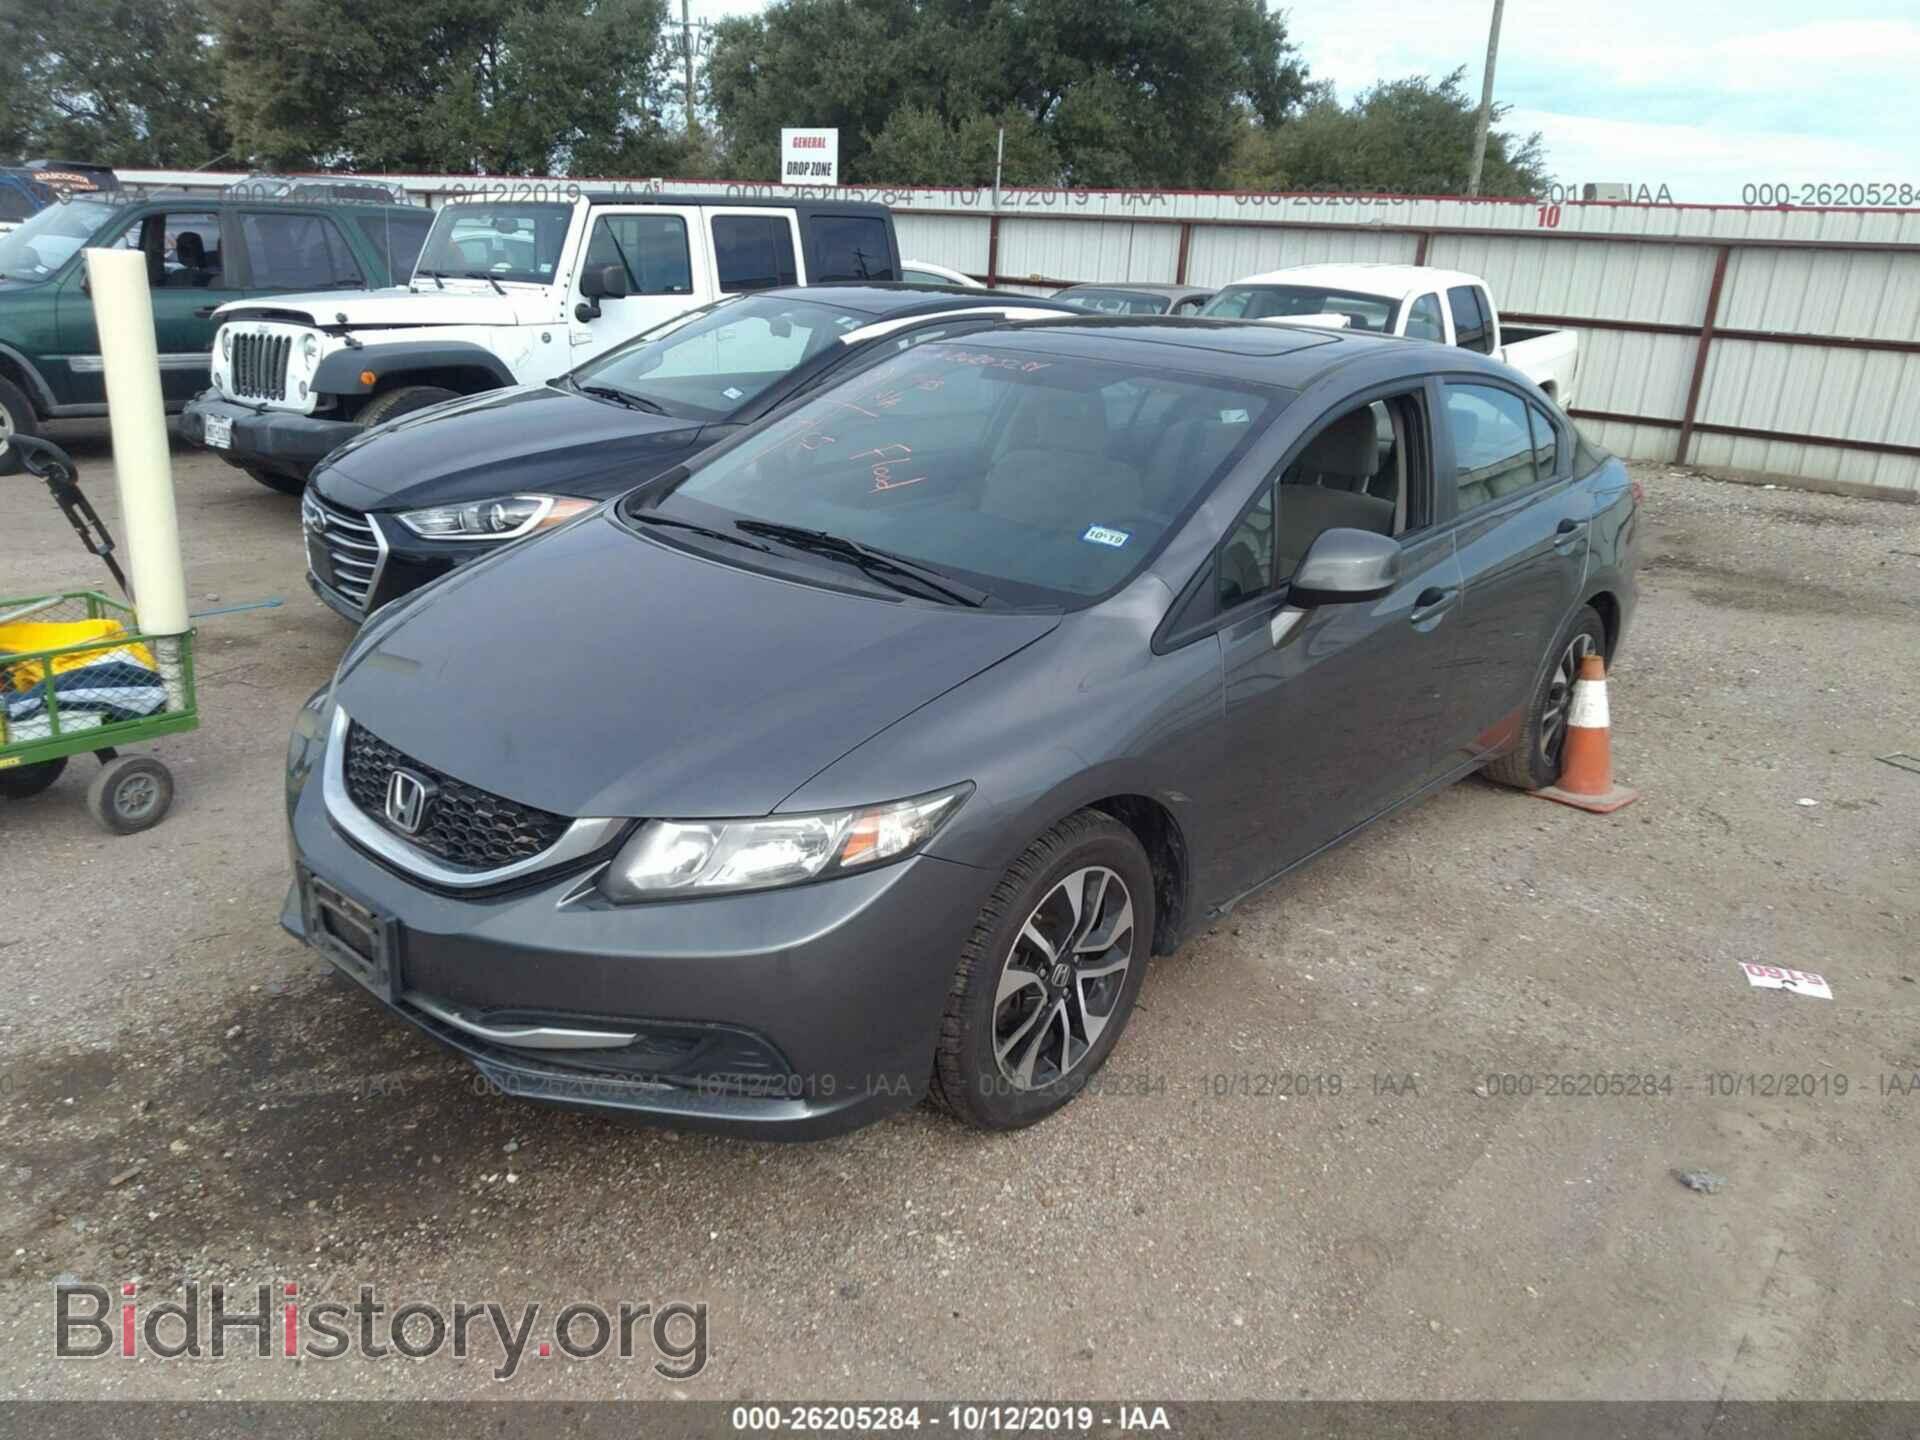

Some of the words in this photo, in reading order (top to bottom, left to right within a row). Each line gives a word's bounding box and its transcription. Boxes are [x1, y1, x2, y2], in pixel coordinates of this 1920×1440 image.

[793, 136, 826, 149] GENERAL
[786, 161, 809, 176] DROP
[811, 162, 832, 177] ZONE
[1537, 205, 1561, 228] 10
